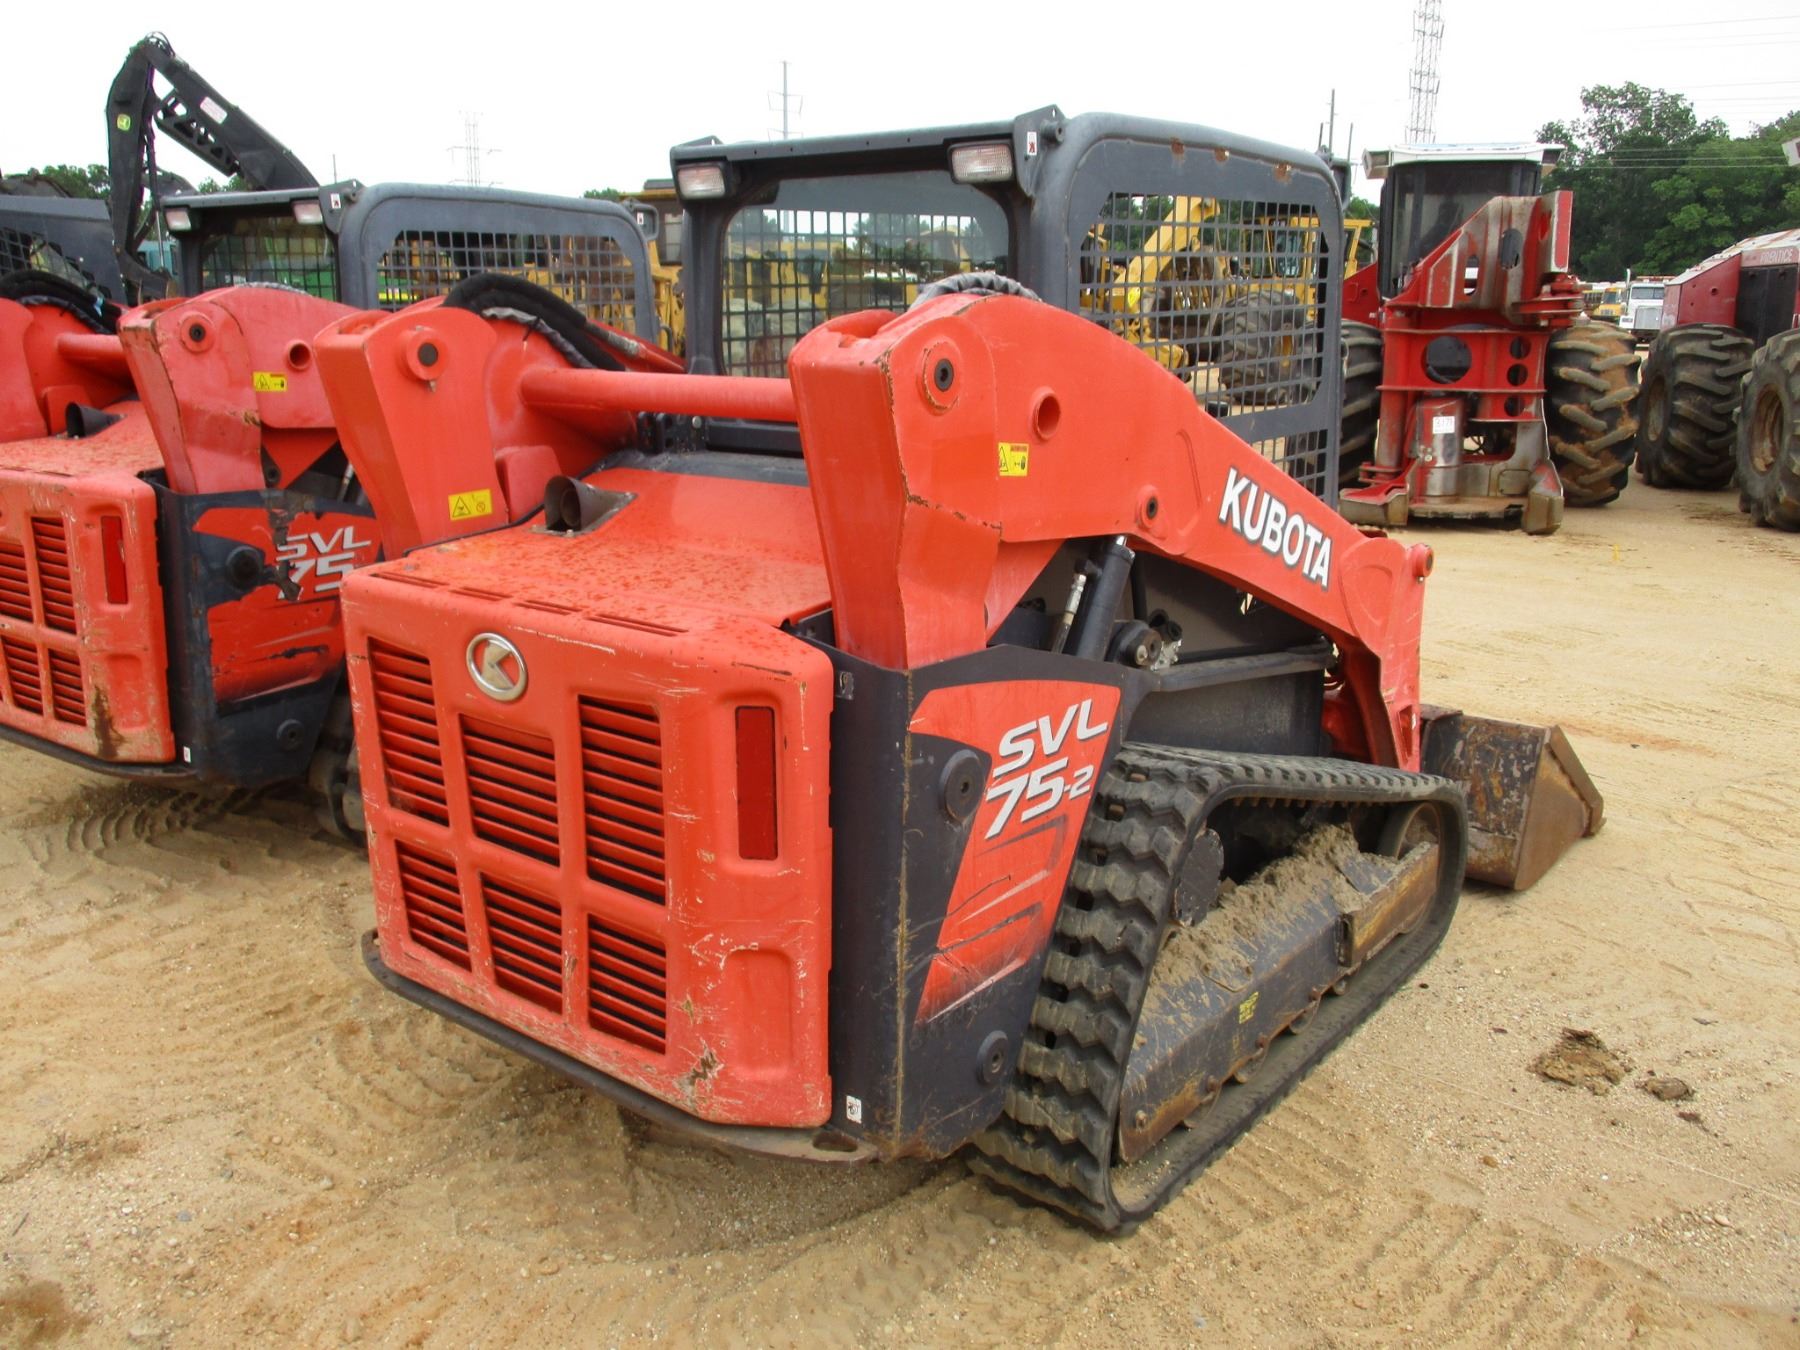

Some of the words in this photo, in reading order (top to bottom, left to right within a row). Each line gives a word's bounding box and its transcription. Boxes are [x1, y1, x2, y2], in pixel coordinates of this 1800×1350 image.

[276, 525, 371, 562] SVL
[1219, 466, 1332, 588] KUBOTA
[992, 698, 1109, 779] SVL
[984, 756, 1095, 840] 75-2
